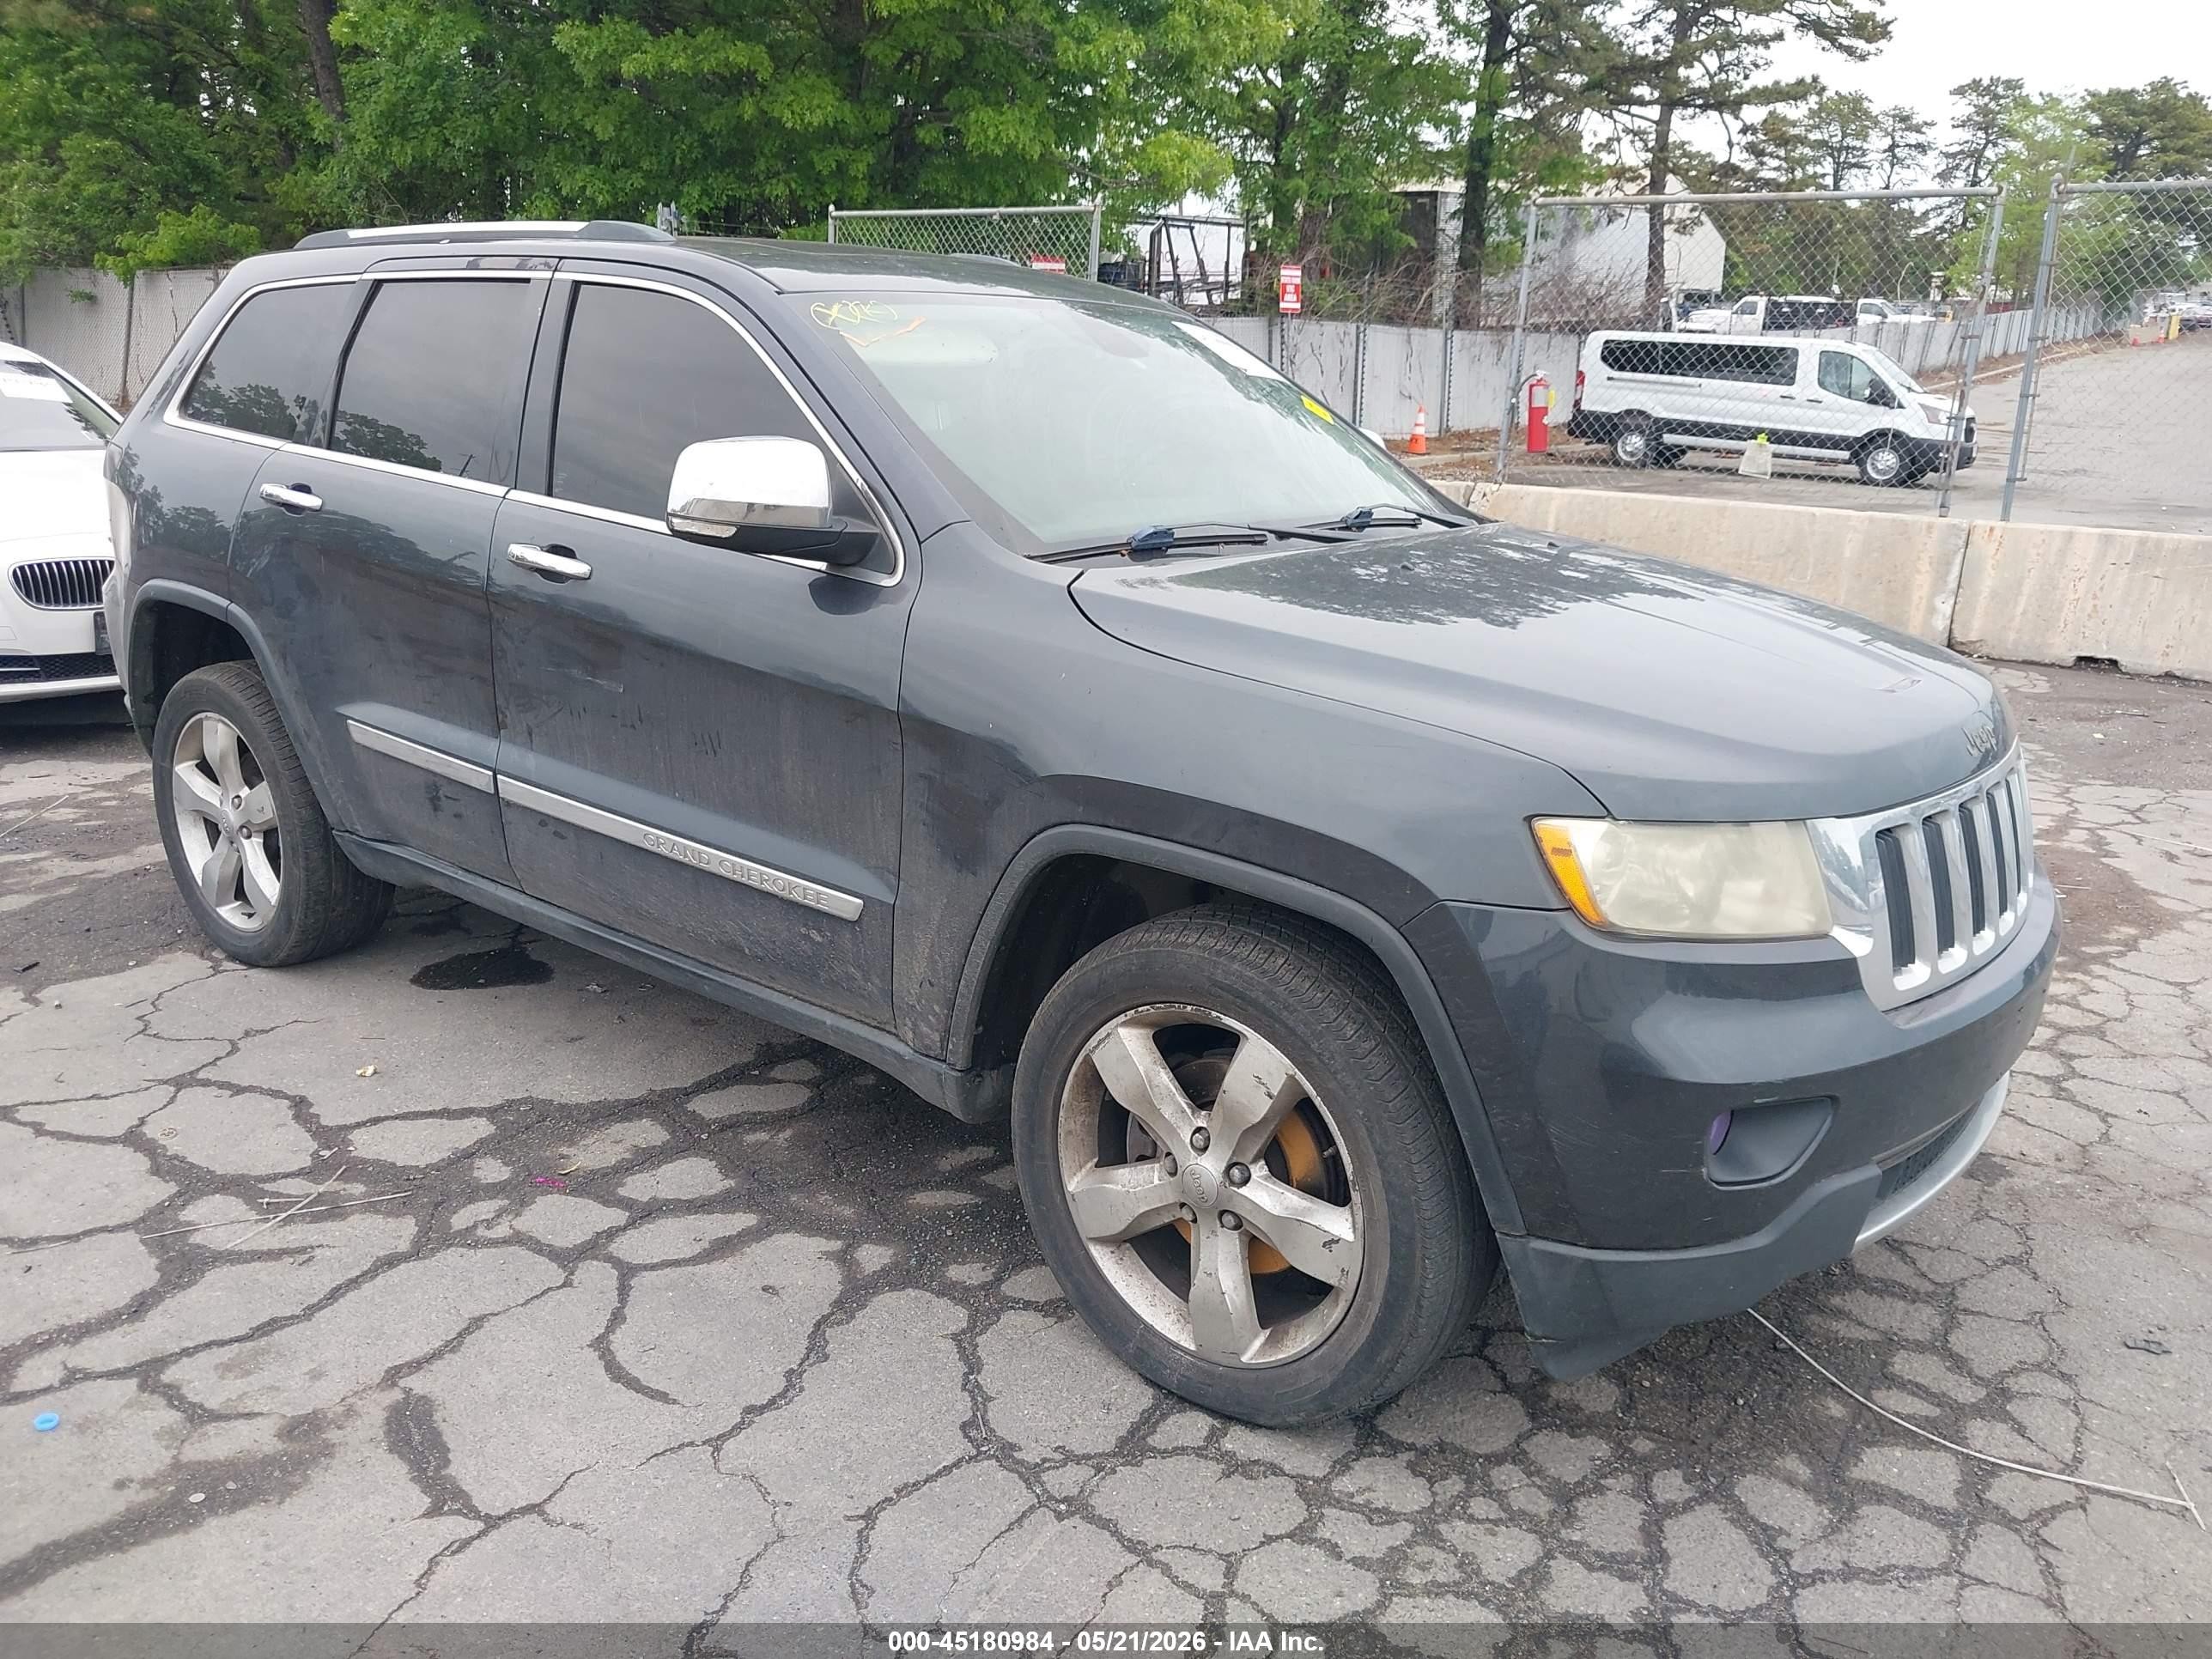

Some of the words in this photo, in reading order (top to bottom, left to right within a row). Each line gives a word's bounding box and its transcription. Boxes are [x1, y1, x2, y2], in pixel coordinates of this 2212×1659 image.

[1960, 726, 1997, 757] Jeep
[641, 832, 711, 867] GRAND
[718, 859, 830, 909] CHEROKEE
[1190, 1167, 1208, 1203] Jeep
